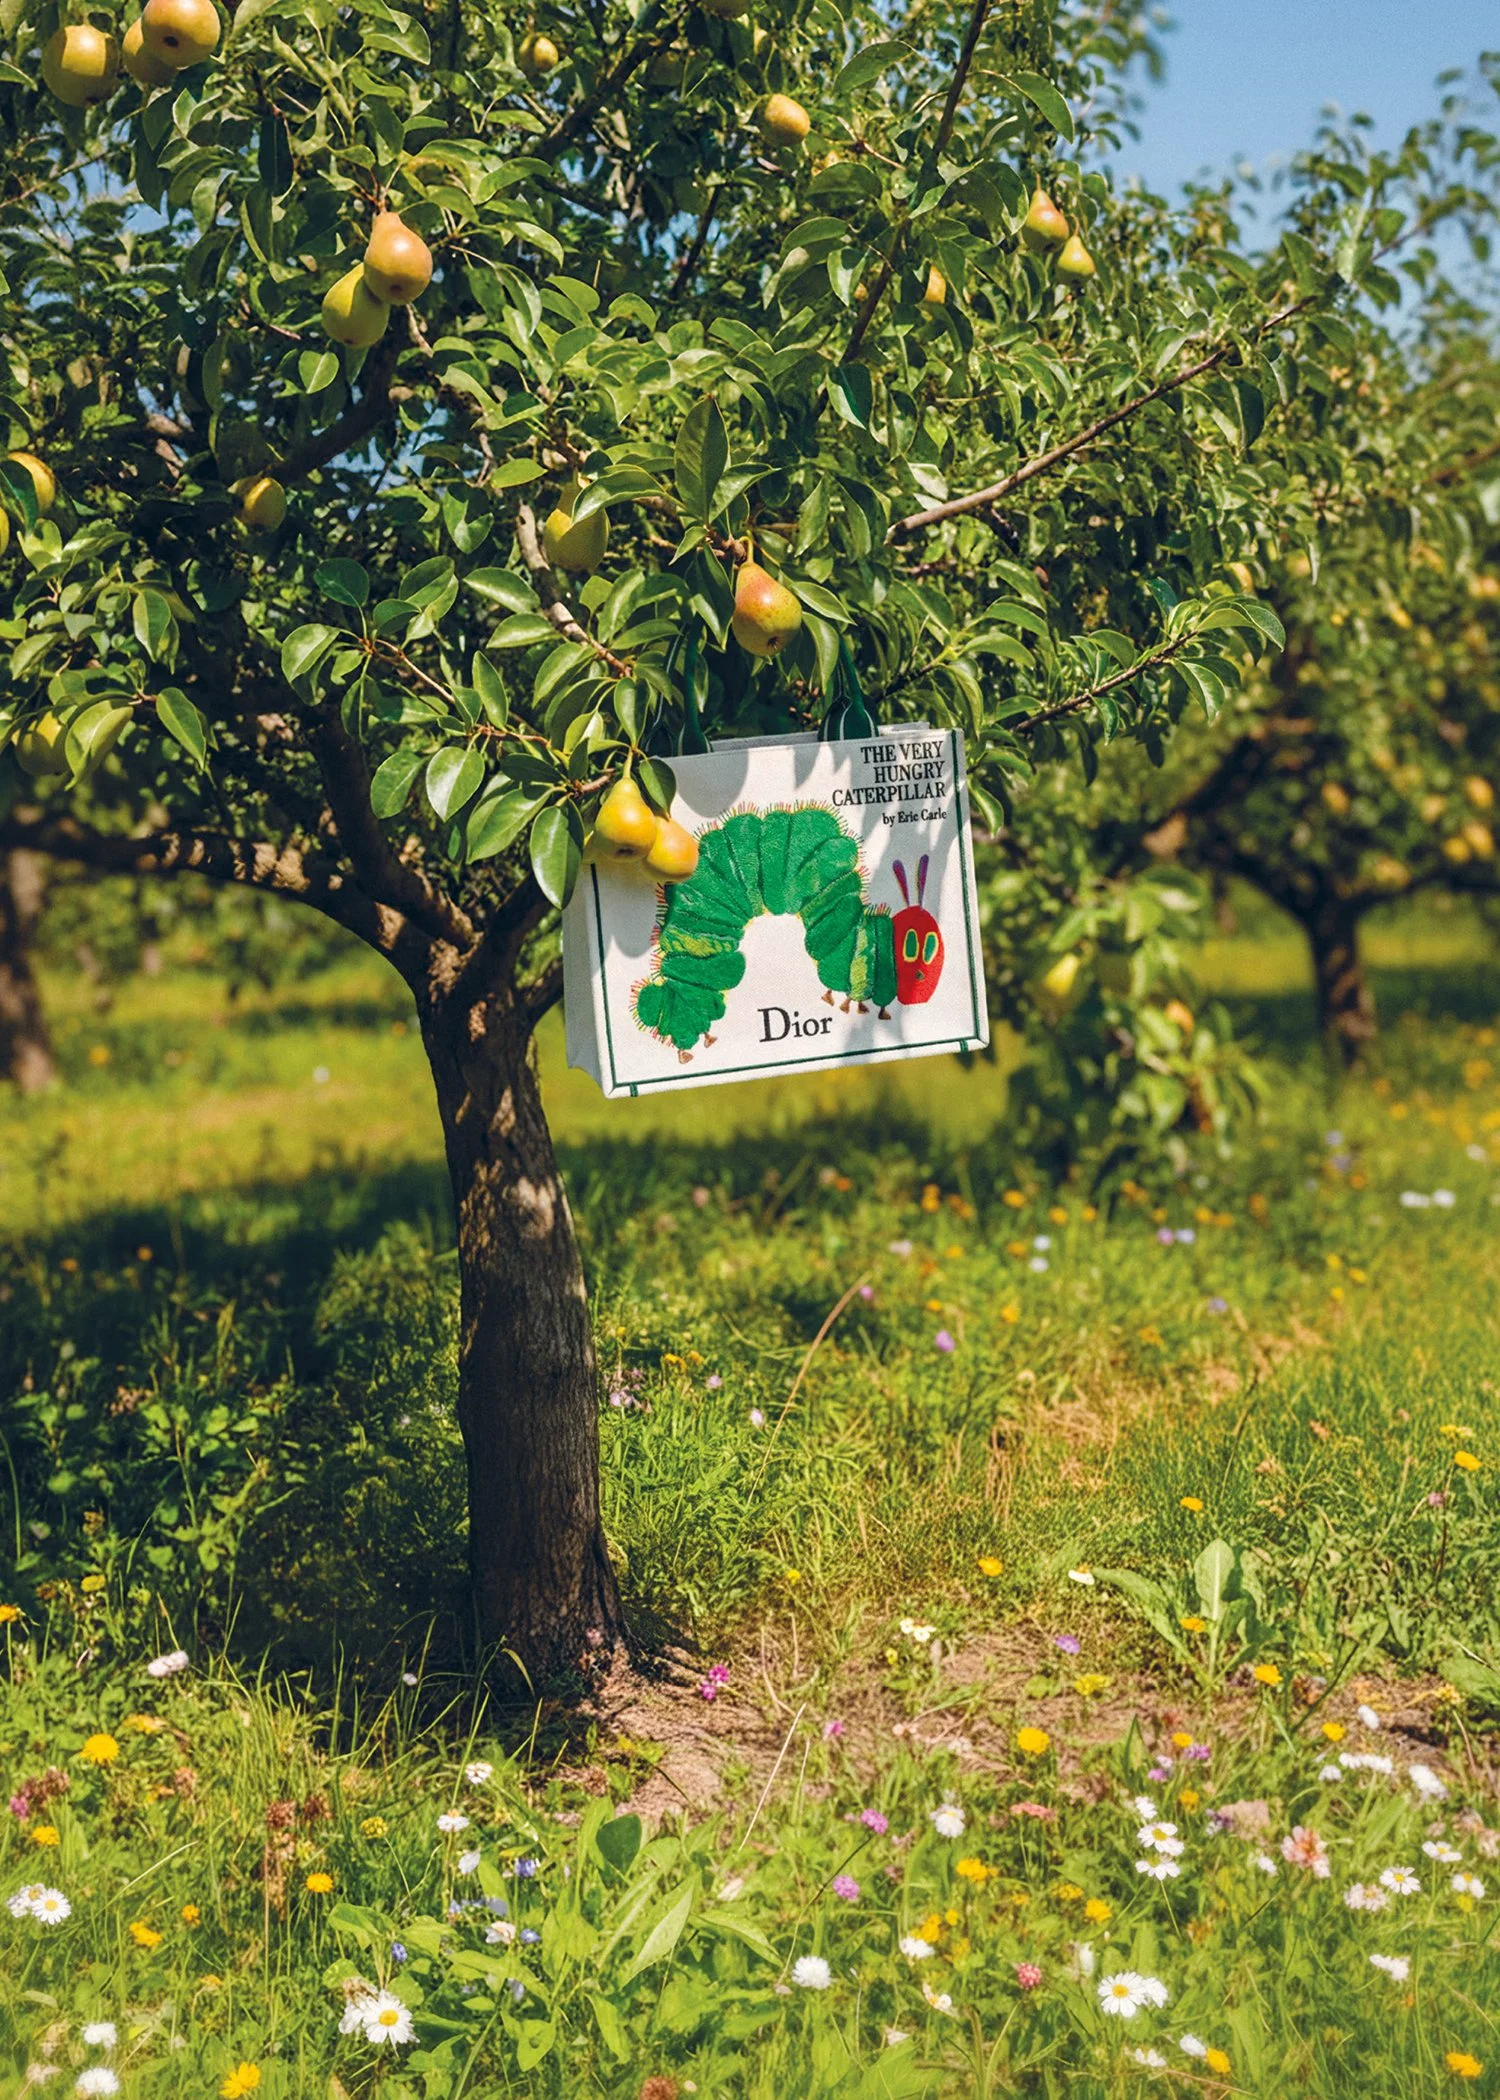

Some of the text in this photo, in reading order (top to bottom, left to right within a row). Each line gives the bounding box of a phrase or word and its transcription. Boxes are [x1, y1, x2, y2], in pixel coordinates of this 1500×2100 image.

[861, 741, 944, 764] THE VERY
[873, 761, 945, 784] HUNGRY
[832, 781, 946, 807] CATERPILLAR
[882, 807, 947, 828] by Eric Carle
[757, 1006, 833, 1043] Dior
